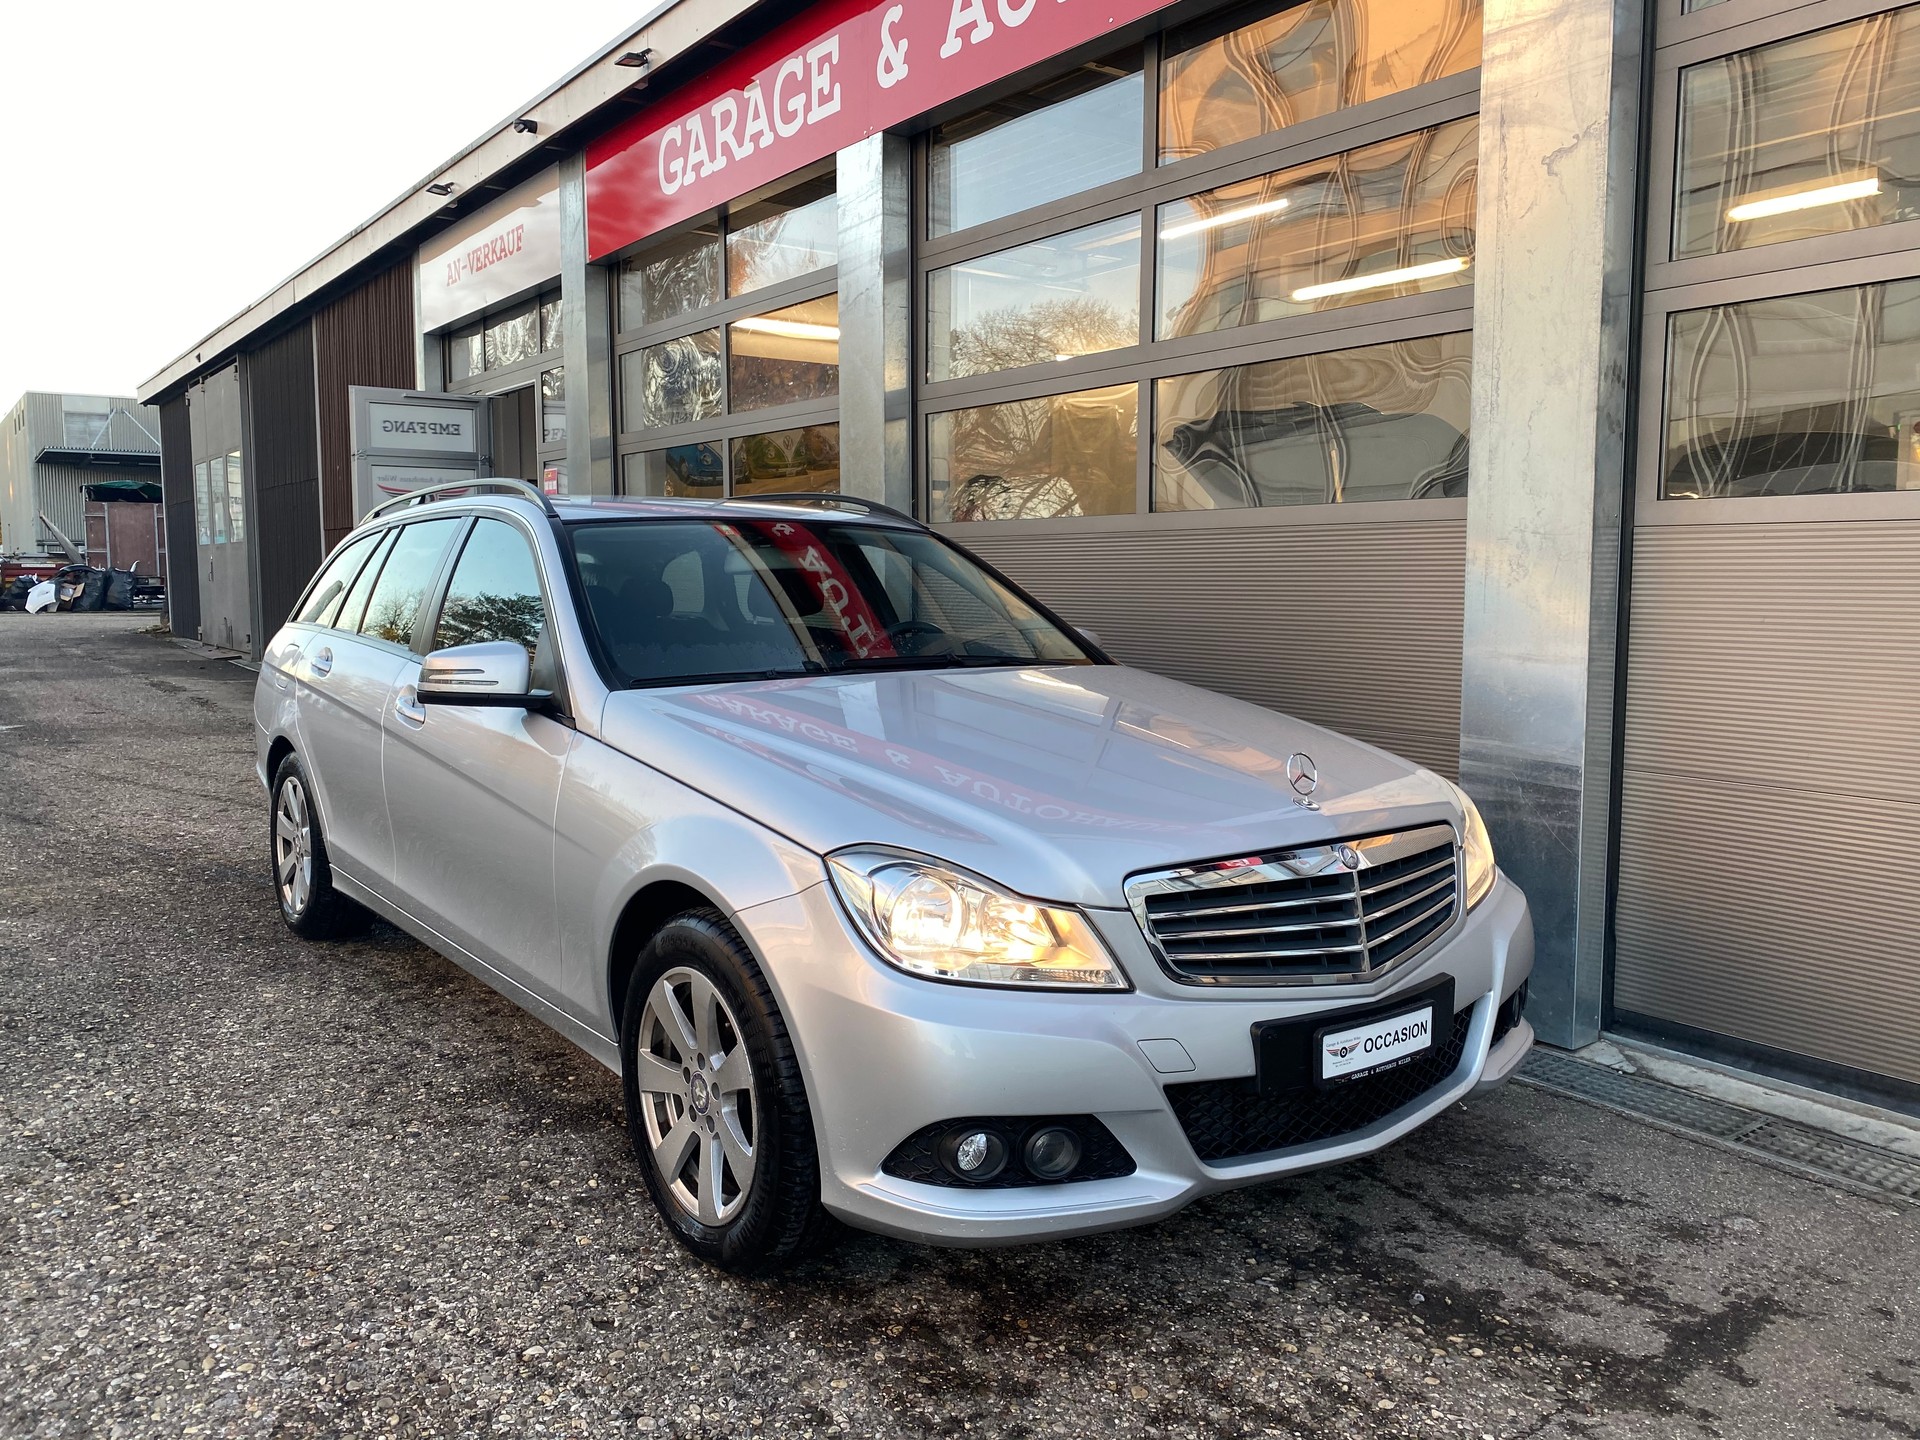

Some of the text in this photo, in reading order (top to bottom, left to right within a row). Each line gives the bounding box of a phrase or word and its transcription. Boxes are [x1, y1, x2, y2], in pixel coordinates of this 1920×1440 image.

[658, 34, 841, 195] GARAGE
[876, 4, 908, 89] &
[447, 224, 524, 287] AN-VERKAUF
[1364, 1020, 1428, 1053] OCCASION
